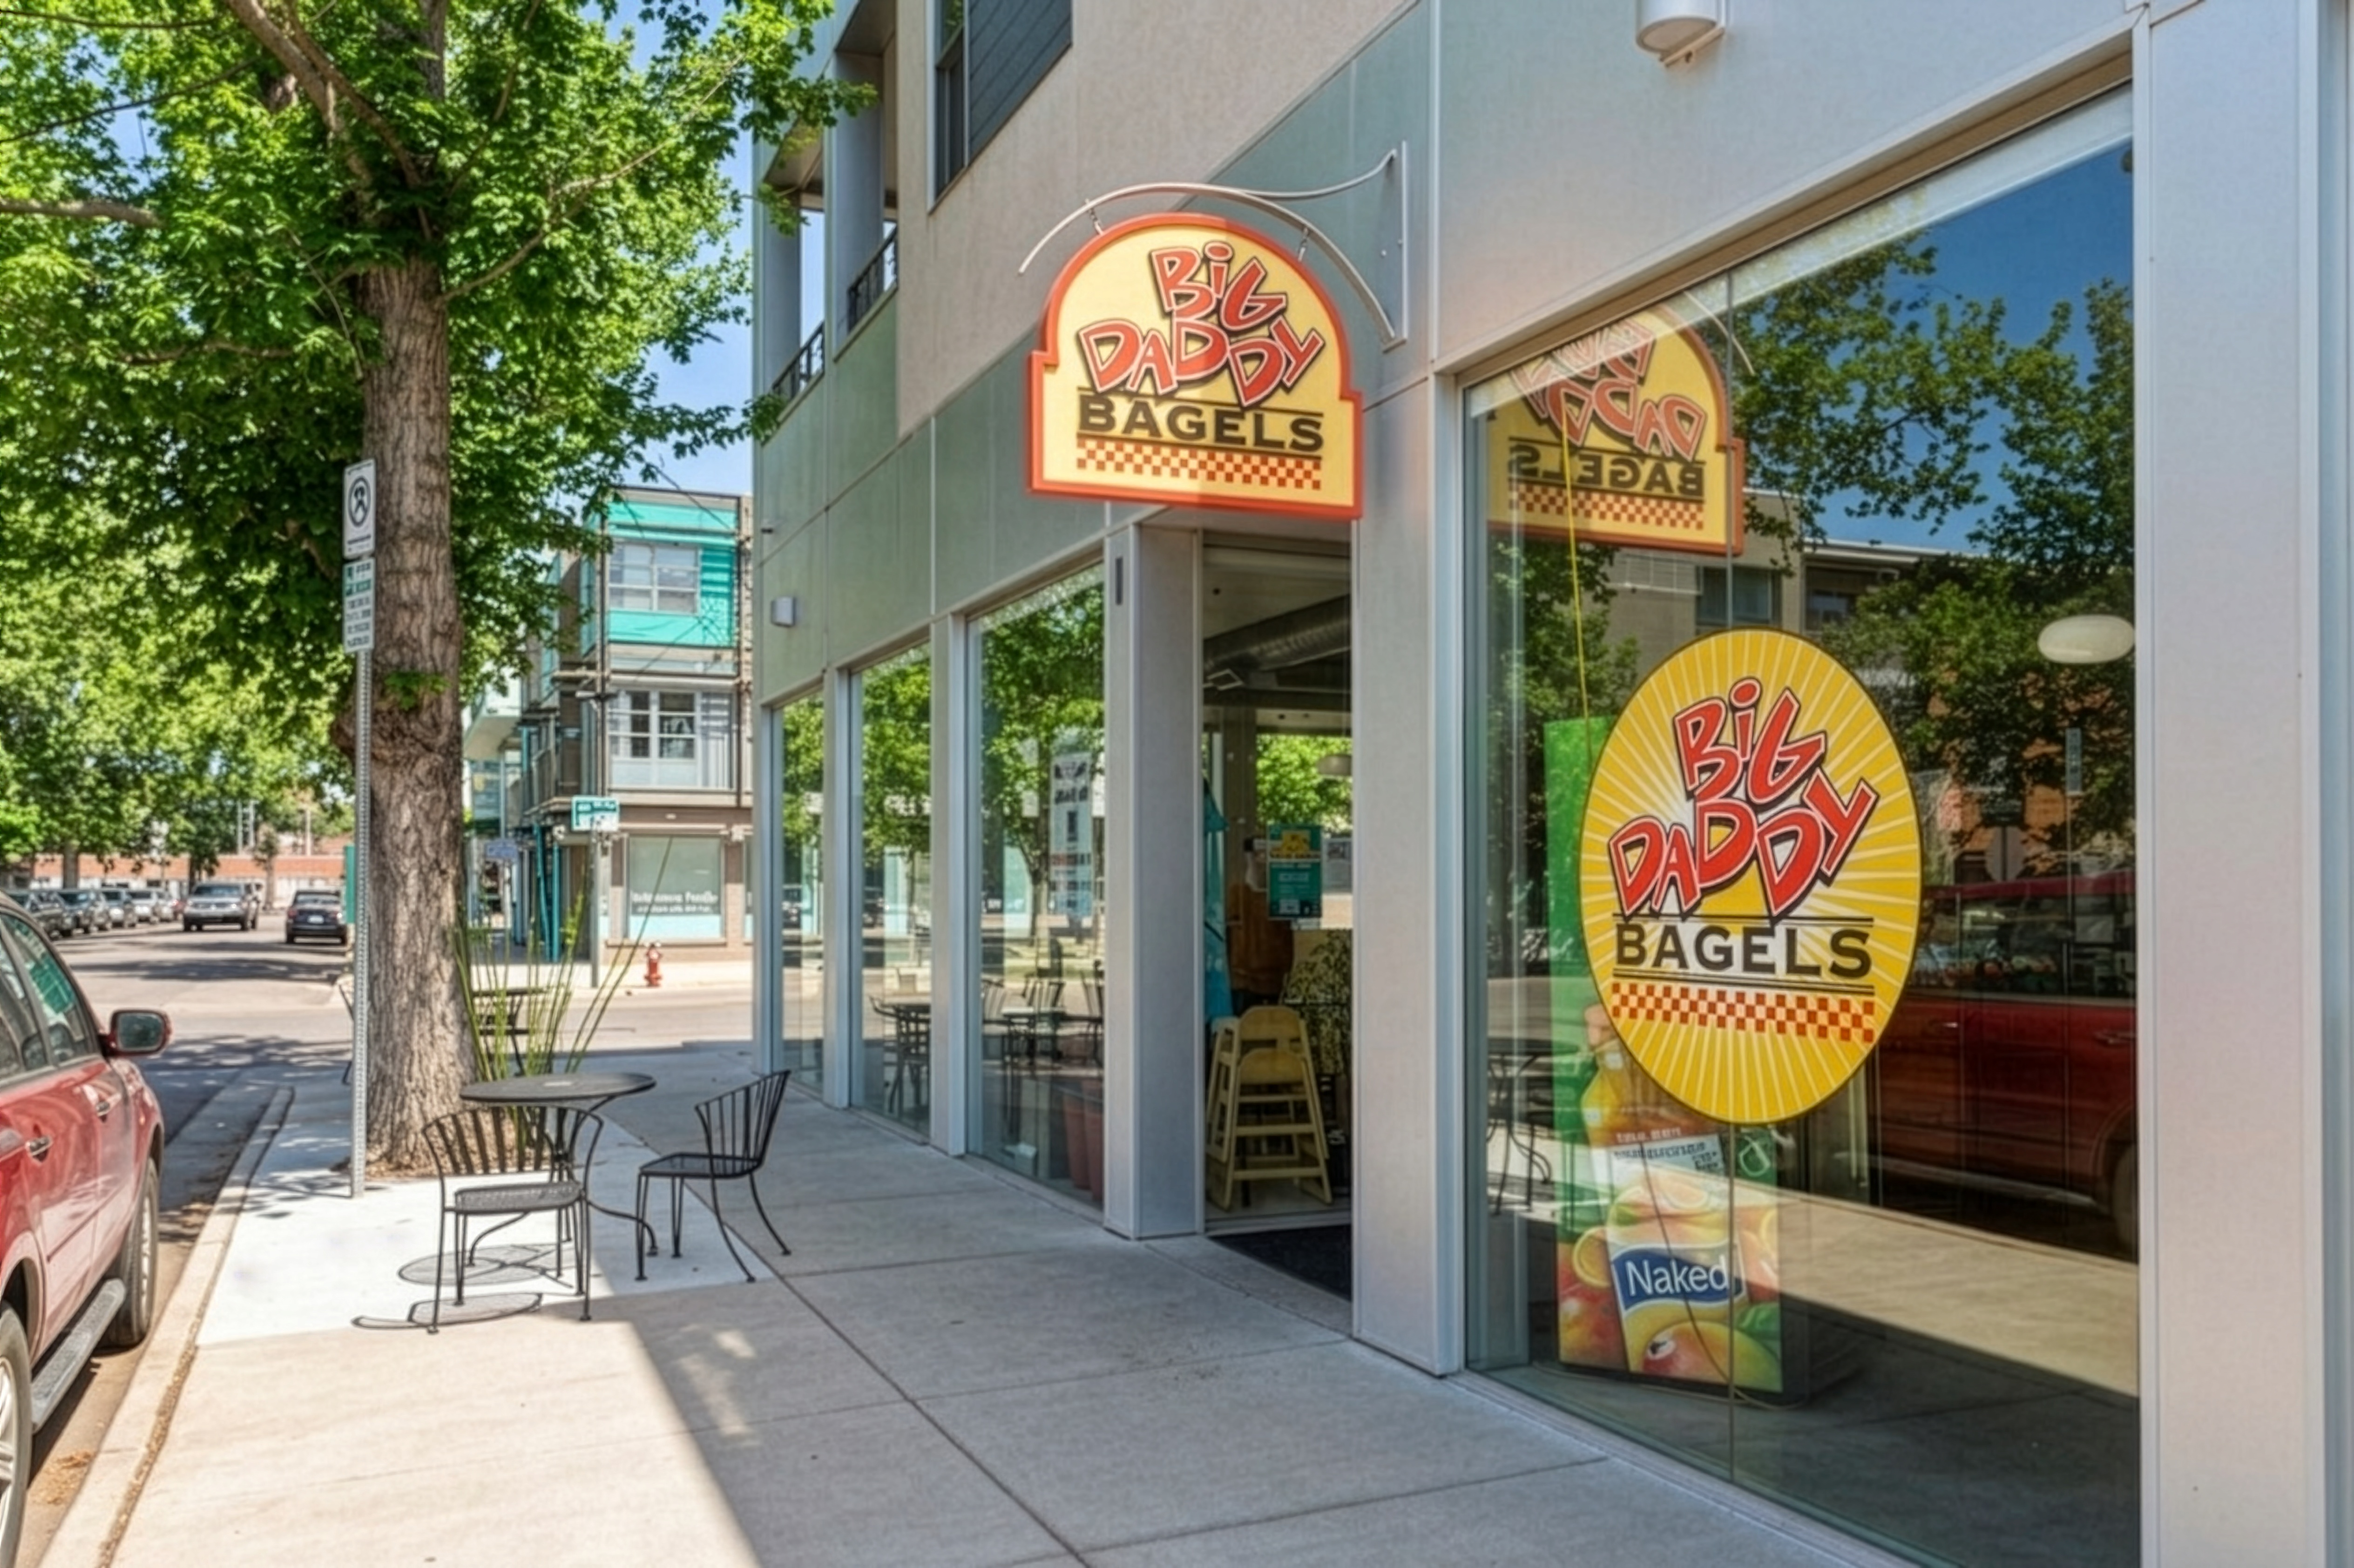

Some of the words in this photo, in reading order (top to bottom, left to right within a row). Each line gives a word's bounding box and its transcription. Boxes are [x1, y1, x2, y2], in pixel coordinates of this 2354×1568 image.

[1077, 315, 1325, 408] DADDY
[1078, 395, 1323, 453] BAGELS
[1609, 768, 1879, 919] DADDY
[1615, 924, 1874, 979] BAGELS
[1625, 1255, 1729, 1297] Naked
